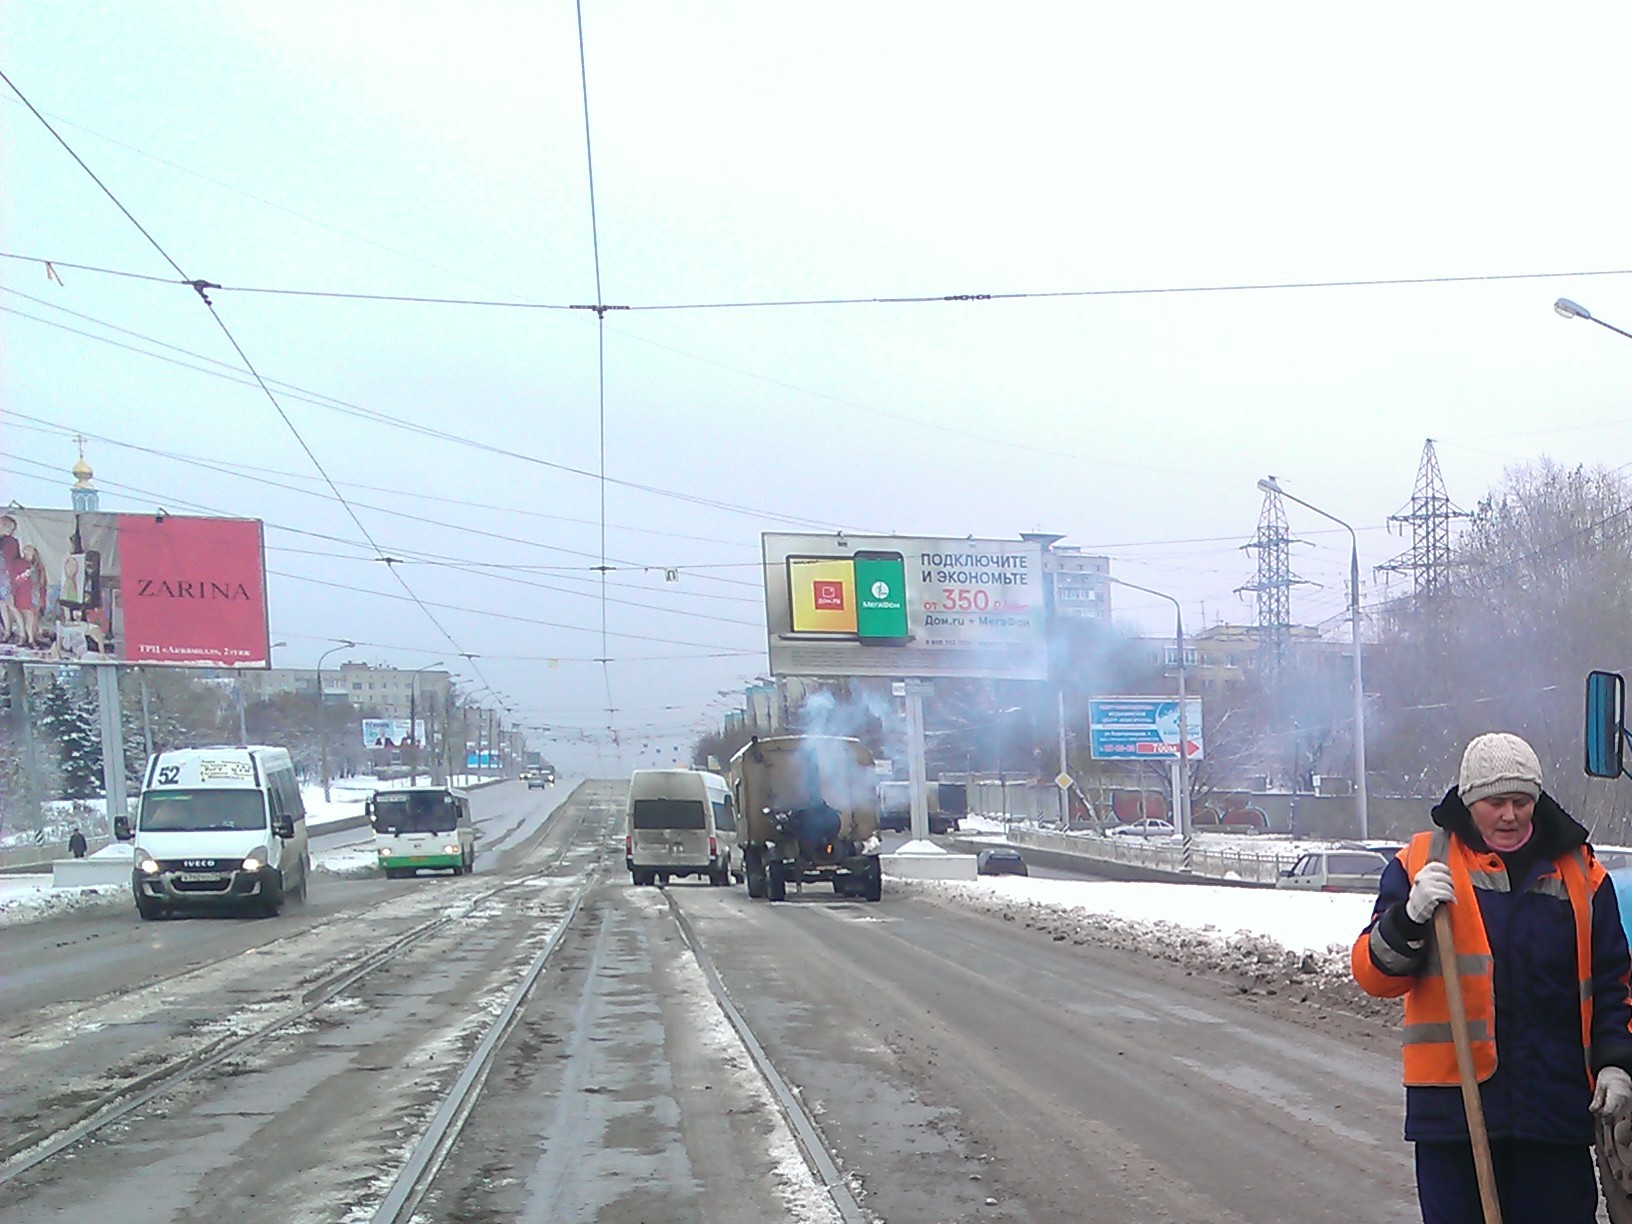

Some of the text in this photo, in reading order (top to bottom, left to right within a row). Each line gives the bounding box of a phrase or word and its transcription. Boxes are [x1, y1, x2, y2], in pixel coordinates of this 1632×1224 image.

[921, 553, 1028, 568] ПОДКЛЮЧИТЕ
[922, 570, 1028, 585] И ЭКОНОМЬТЕ
[137, 579, 251, 601] ZARINA
[924, 602, 938, 611] от
[942, 588, 990, 612] 350
[138, 644, 160, 654] ТРЦ
[157, 765, 180, 785] 52
[183, 859, 215, 868] IVECO
